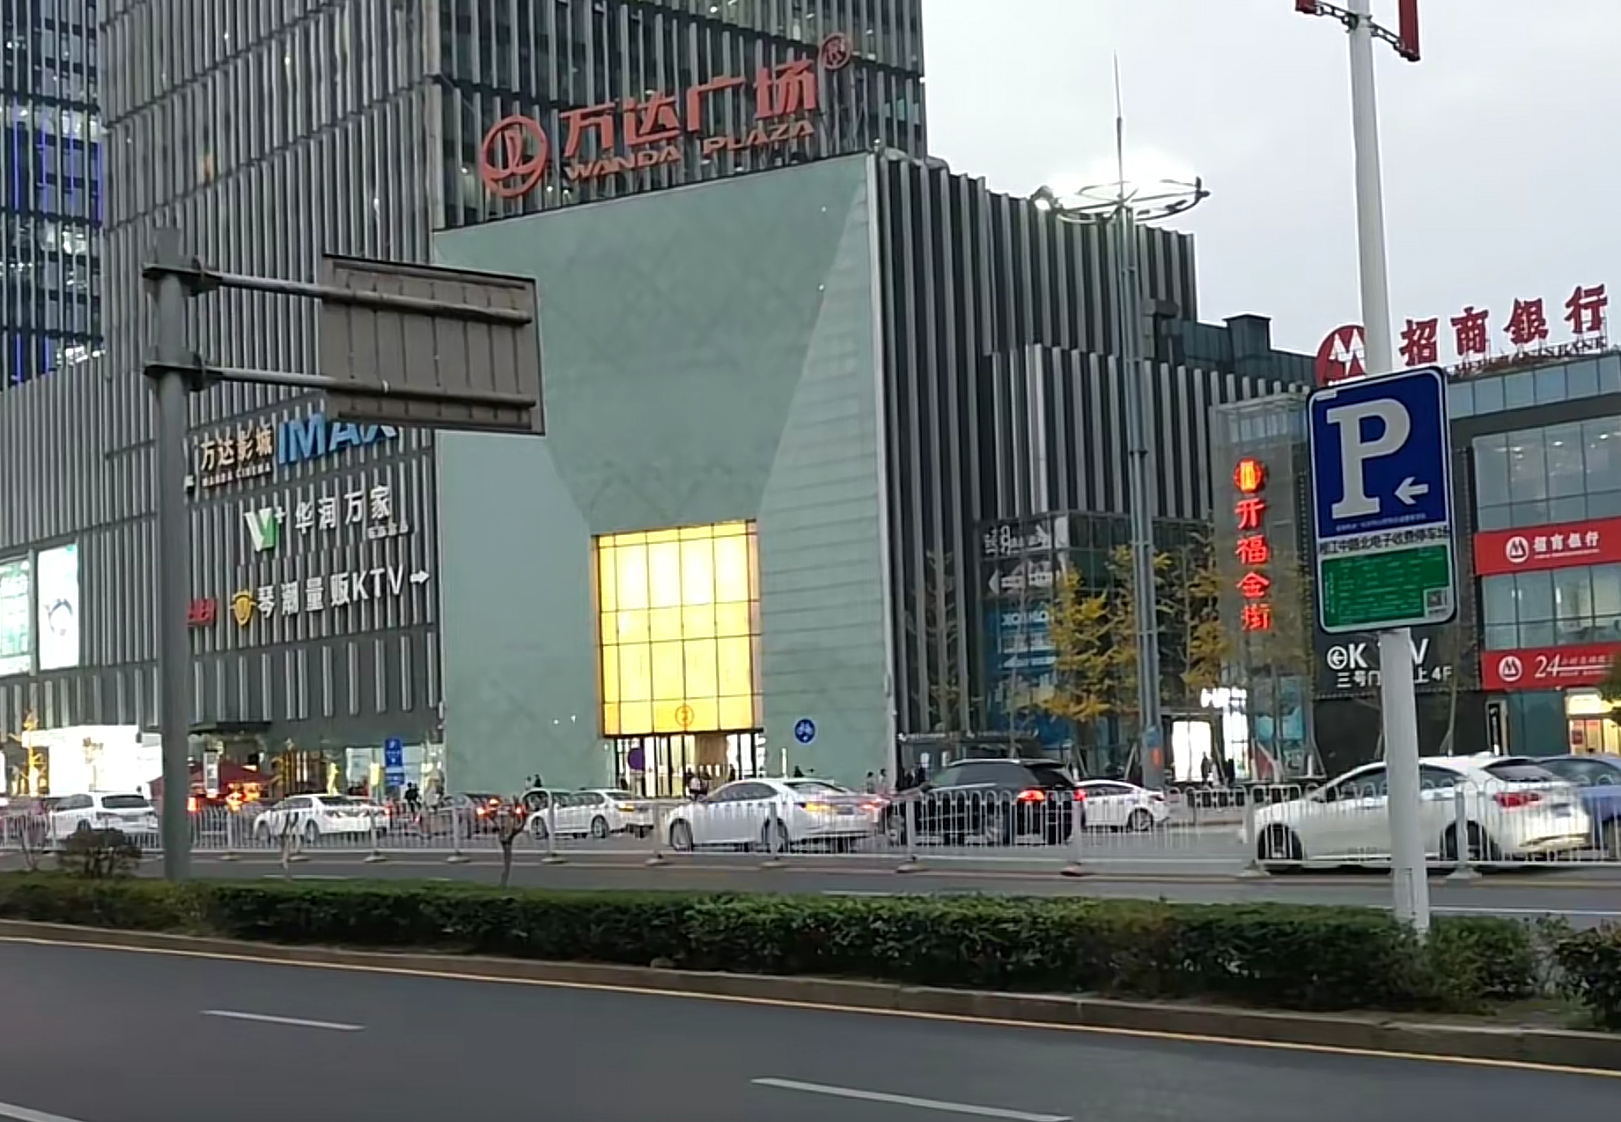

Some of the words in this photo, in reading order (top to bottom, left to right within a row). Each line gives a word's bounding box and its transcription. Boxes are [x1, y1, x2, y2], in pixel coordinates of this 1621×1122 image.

[560, 56, 818, 157] 万达广场
[565, 146, 682, 181] WANDA
[703, 119, 816, 155] PLAZA
[1326, 398, 1411, 519] P
[295, 485, 391, 534] 华润万家
[1235, 498, 1270, 632] 开福金街
[1348, 638, 1429, 669] KV
[1535, 654, 1561, 678] 24
